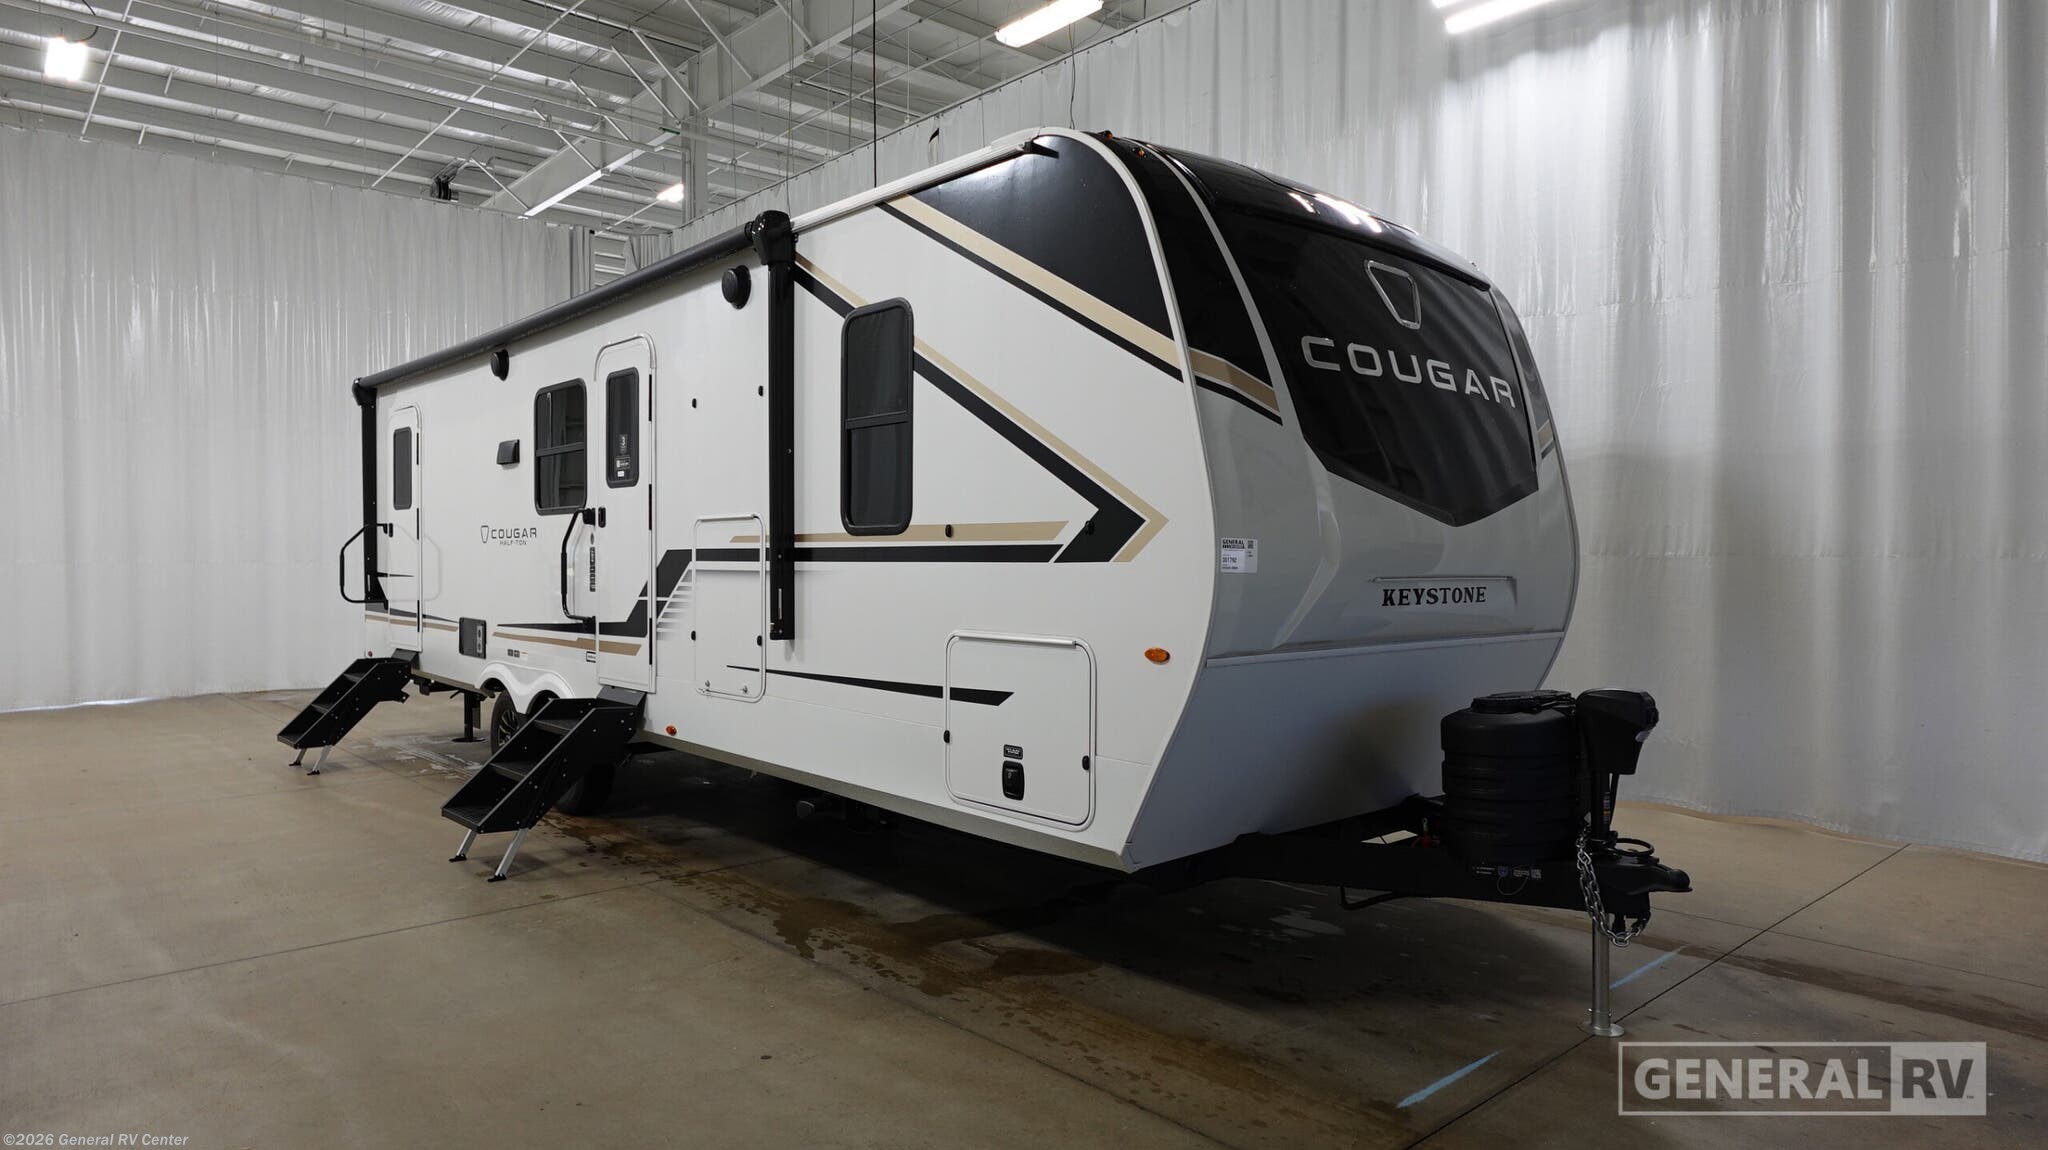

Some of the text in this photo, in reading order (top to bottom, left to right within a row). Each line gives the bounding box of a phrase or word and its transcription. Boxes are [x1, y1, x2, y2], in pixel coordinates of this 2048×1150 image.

[1301, 335, 1515, 408] COUGAR
[490, 527, 537, 539] COUGAR
[1382, 586, 1487, 607] KEYSTONE
